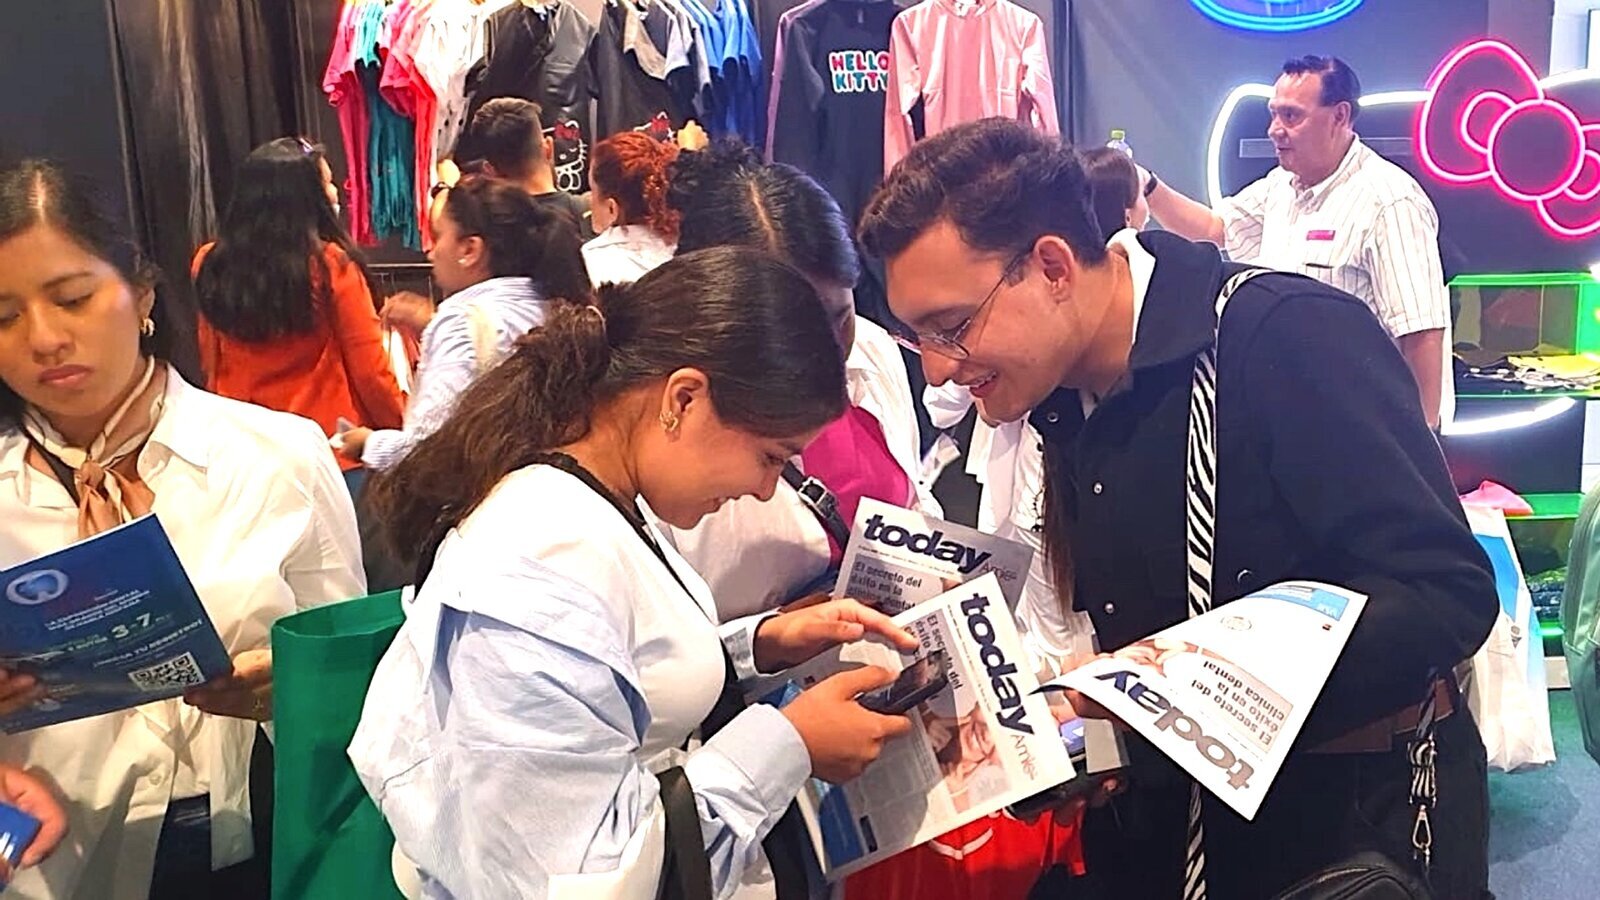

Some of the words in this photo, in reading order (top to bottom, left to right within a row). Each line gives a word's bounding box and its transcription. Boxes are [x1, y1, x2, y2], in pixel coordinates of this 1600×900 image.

[829, 51, 889, 72] HELLO
[832, 72, 888, 92] KITTY
[864, 514, 991, 574] today
[854, 561, 866, 572] El
[867, 566, 904, 583] secreto
[905, 576, 922, 588] del
[892, 584, 903, 596] la
[926, 613, 939, 627] El
[948, 670, 964, 690] del
[960, 593, 1035, 735] today
[1191, 679, 1212, 697] del
[1203, 660, 1243, 689] dental
[1216, 681, 1230, 696] la
[1231, 692, 1247, 707] en
[1213, 695, 1259, 733] secreto
[1248, 705, 1279, 733] éxito
[1094, 669, 1255, 790] today
[1258, 730, 1273, 746] El
